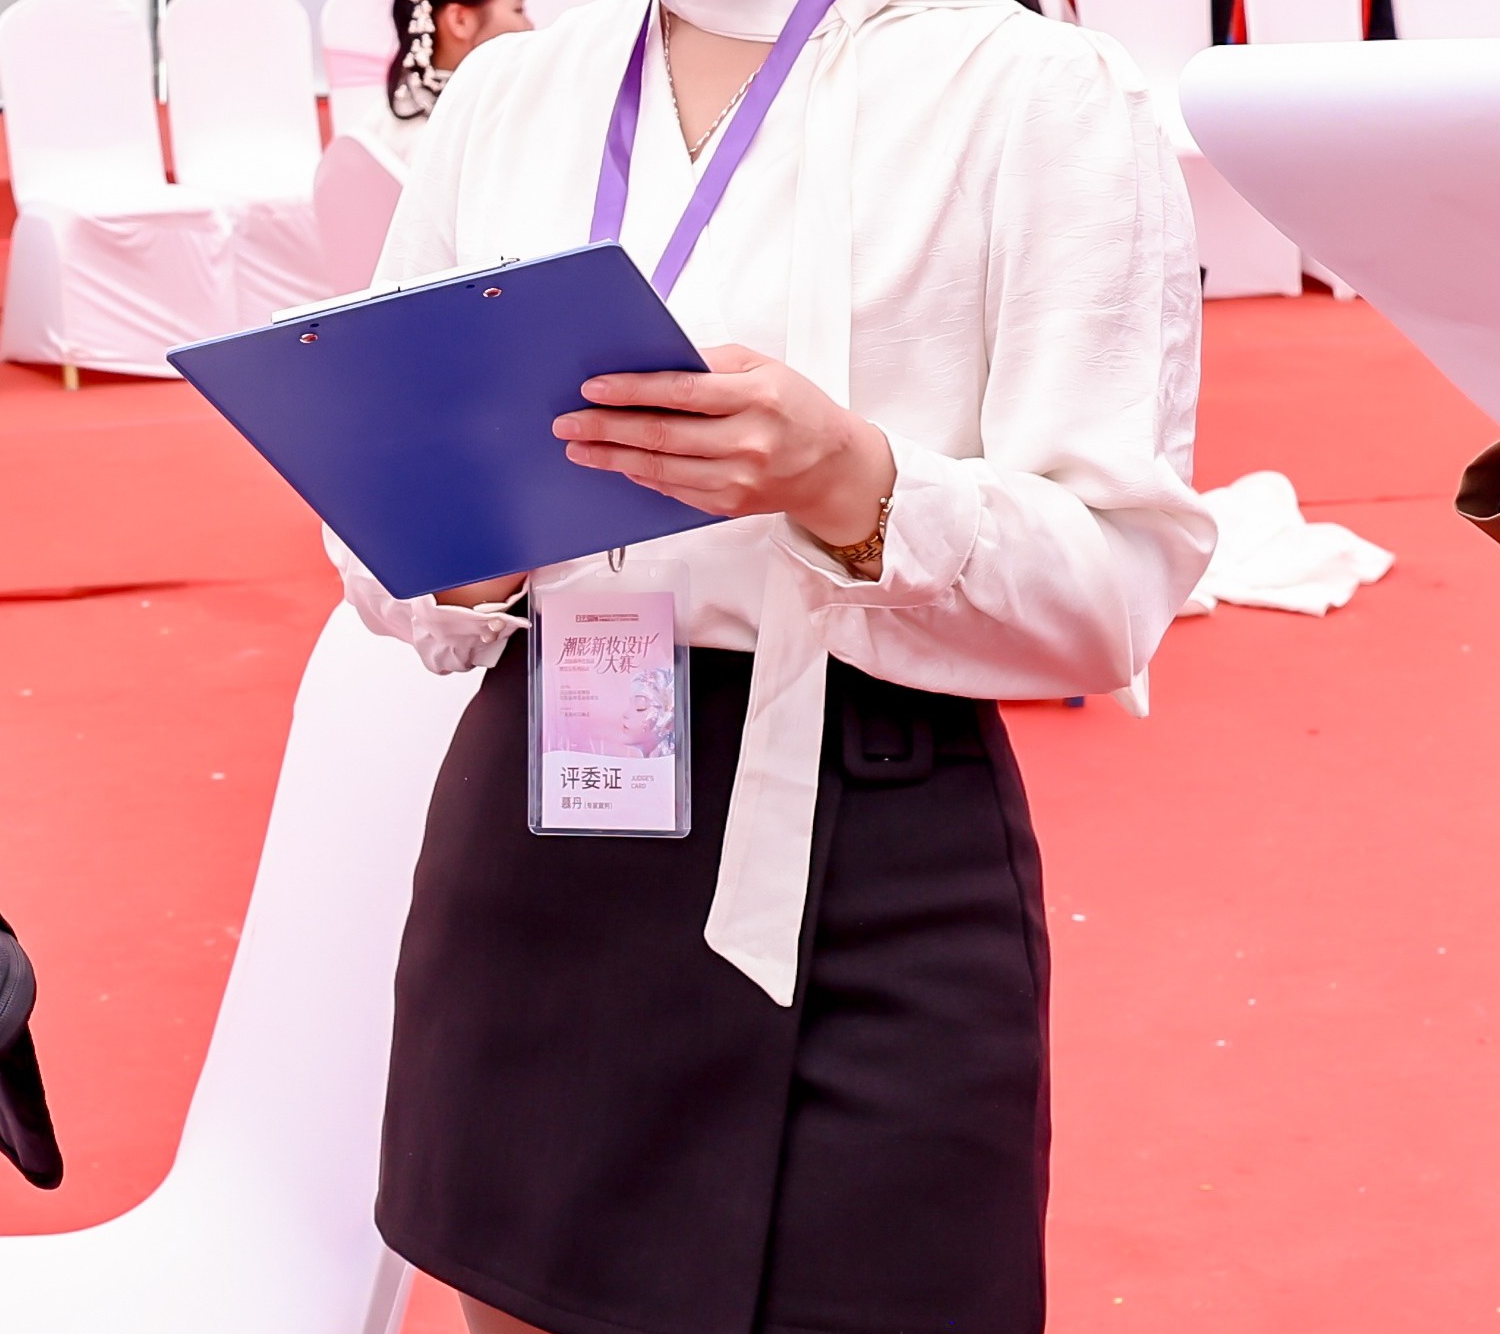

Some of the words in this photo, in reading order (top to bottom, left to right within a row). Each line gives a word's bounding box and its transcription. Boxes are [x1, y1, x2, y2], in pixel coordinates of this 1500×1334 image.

[557, 632, 661, 667] 潮影新妆设计
[597, 654, 639, 675] 大赛
[560, 766, 623, 791] 评委证
[630, 782, 647, 790] CARD
